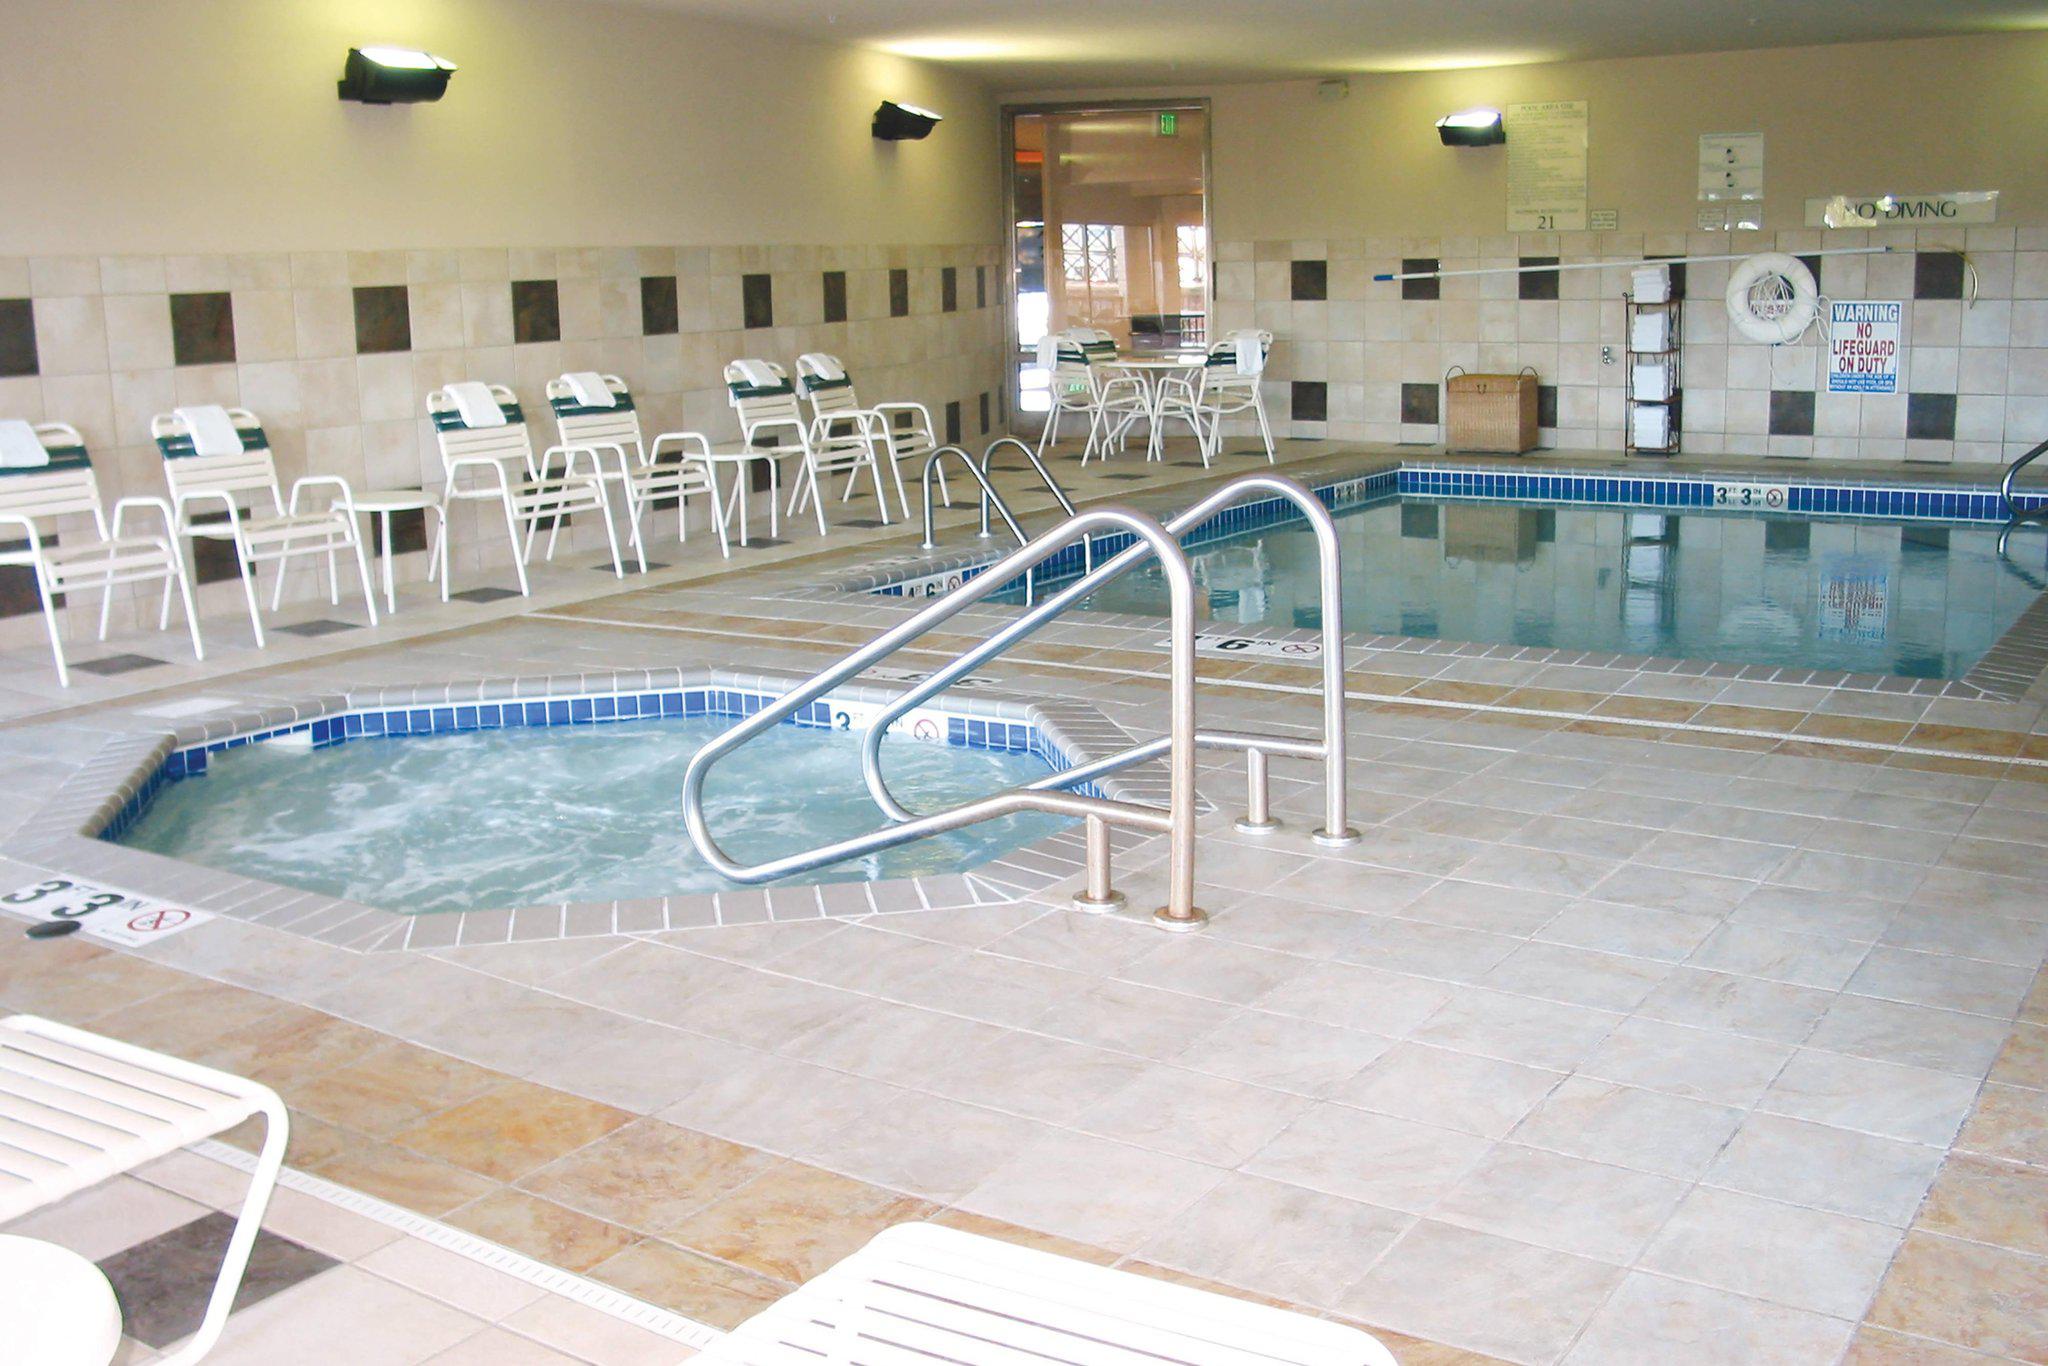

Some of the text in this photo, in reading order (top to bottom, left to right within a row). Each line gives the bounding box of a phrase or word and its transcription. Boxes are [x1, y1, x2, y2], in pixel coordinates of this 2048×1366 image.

[1884, 201, 1957, 219] DIVING
[1537, 215, 1555, 230] 21
[1834, 304, 1898, 322] WARNING
[1856, 322, 1873, 339] NO
[1832, 339, 1895, 356] LIFEGUARD
[1838, 356, 1888, 374] ON DUTY
[1717, 487, 1727, 504] 3
[1741, 488, 1751, 505] 3
[1216, 639, 1256, 650] 6
[0, 880, 73, 904] 3
[51, 893, 125, 918] 3
